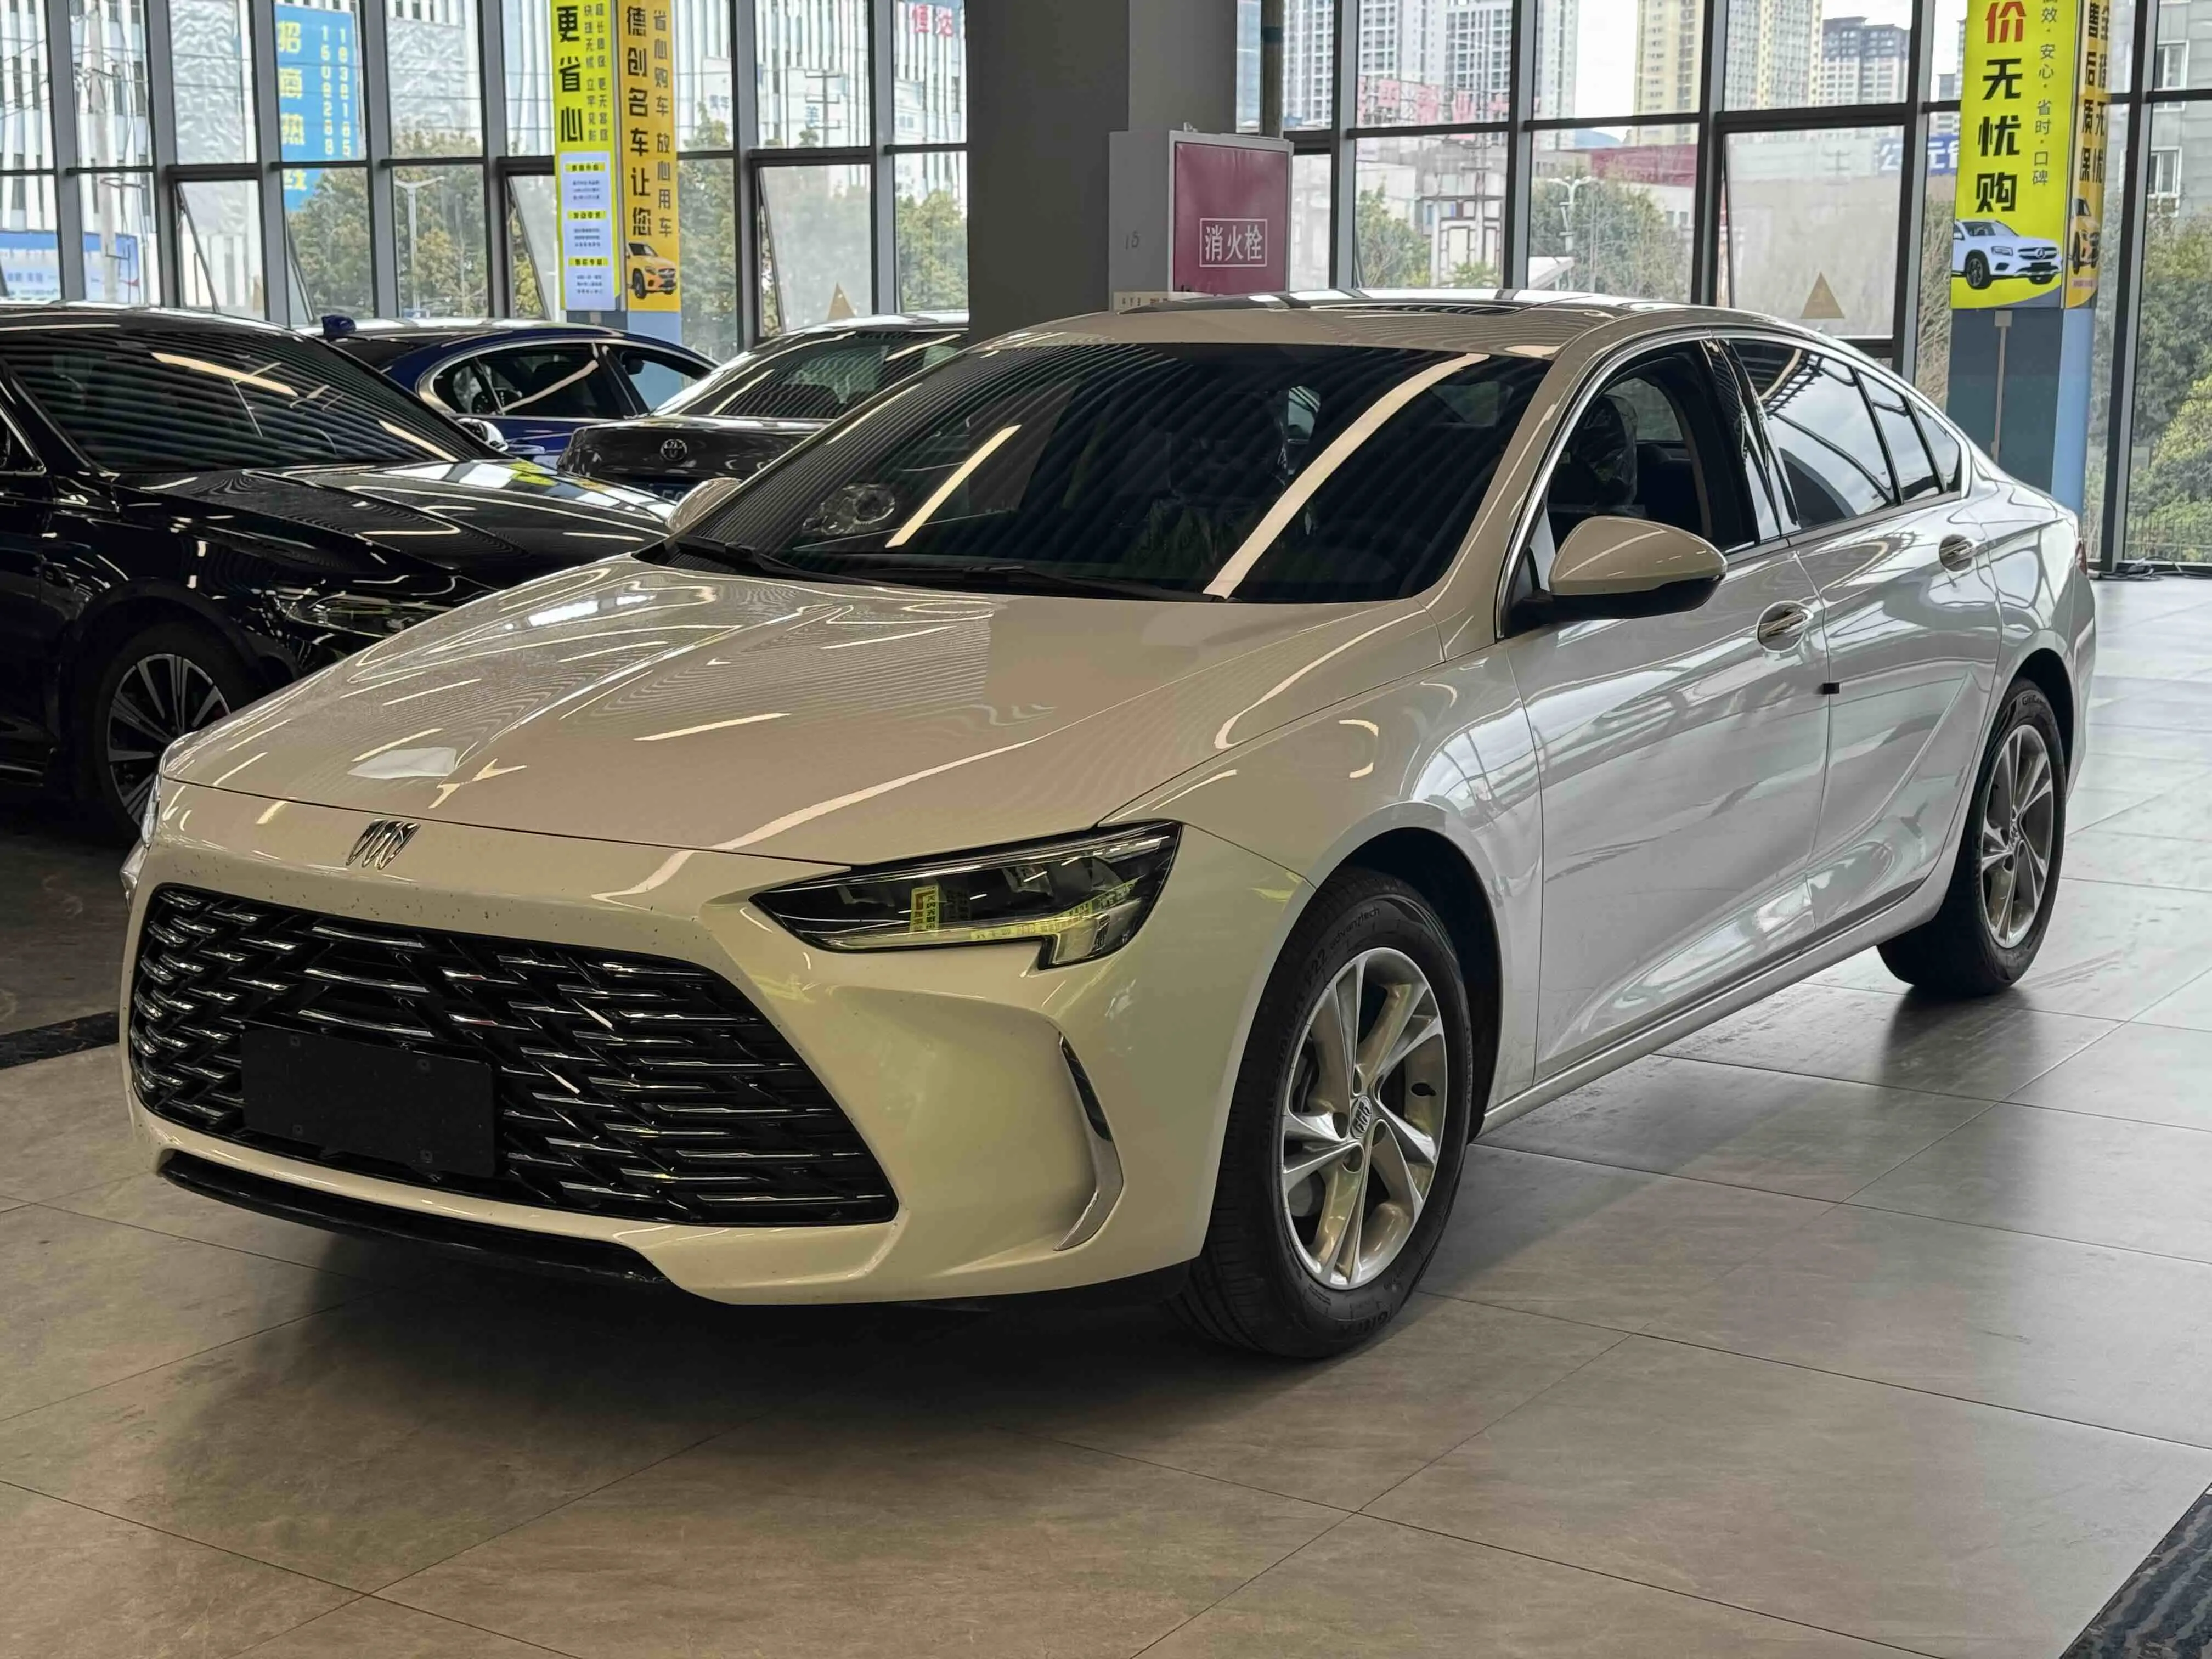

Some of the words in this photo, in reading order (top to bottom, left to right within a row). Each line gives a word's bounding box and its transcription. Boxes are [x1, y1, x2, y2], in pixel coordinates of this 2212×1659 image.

[557, 5, 583, 143] 更省心
[1975, 1, 2027, 213] 价无忧购
[2032, 0, 2058, 186] 效·安心·省时·口碑
[2079, 2, 2100, 182] 售后质保
[1205, 224, 1263, 262] 消火栓
